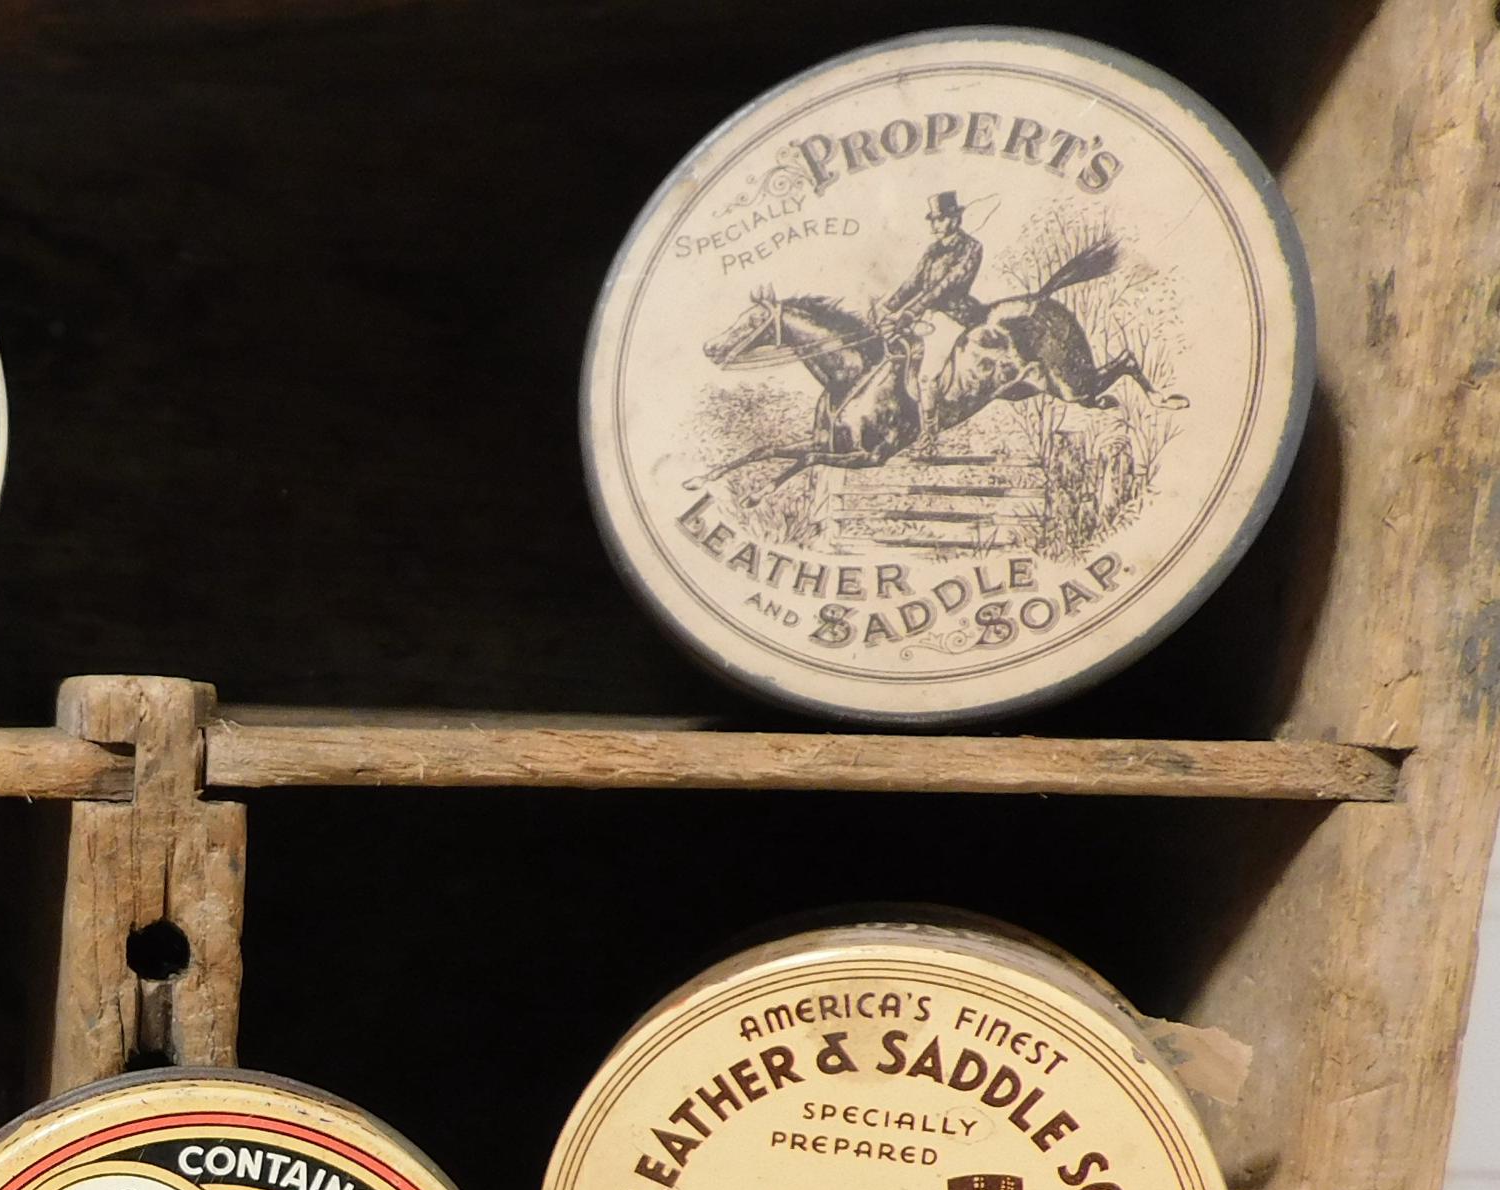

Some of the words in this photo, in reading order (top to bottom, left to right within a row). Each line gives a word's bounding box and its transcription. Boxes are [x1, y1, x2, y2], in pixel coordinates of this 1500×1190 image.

[797, 111, 1124, 196] PROPERT'S
[674, 193, 806, 259] SPECIALLY
[720, 216, 861, 275] PREPARED
[674, 494, 913, 599] LEATHER
[744, 591, 799, 629] AND
[810, 557, 1036, 650] SADDLE
[975, 550, 1133, 648] SOAP.
[738, 992, 932, 1042] AMERICA'S
[954, 1005, 1070, 1075] FINEST
[802, 1101, 980, 1137] SPECIALLY
[816, 1031, 859, 1075] &
[875, 1030, 1080, 1153] SADDLE
[771, 1131, 938, 1166] PREPARED
